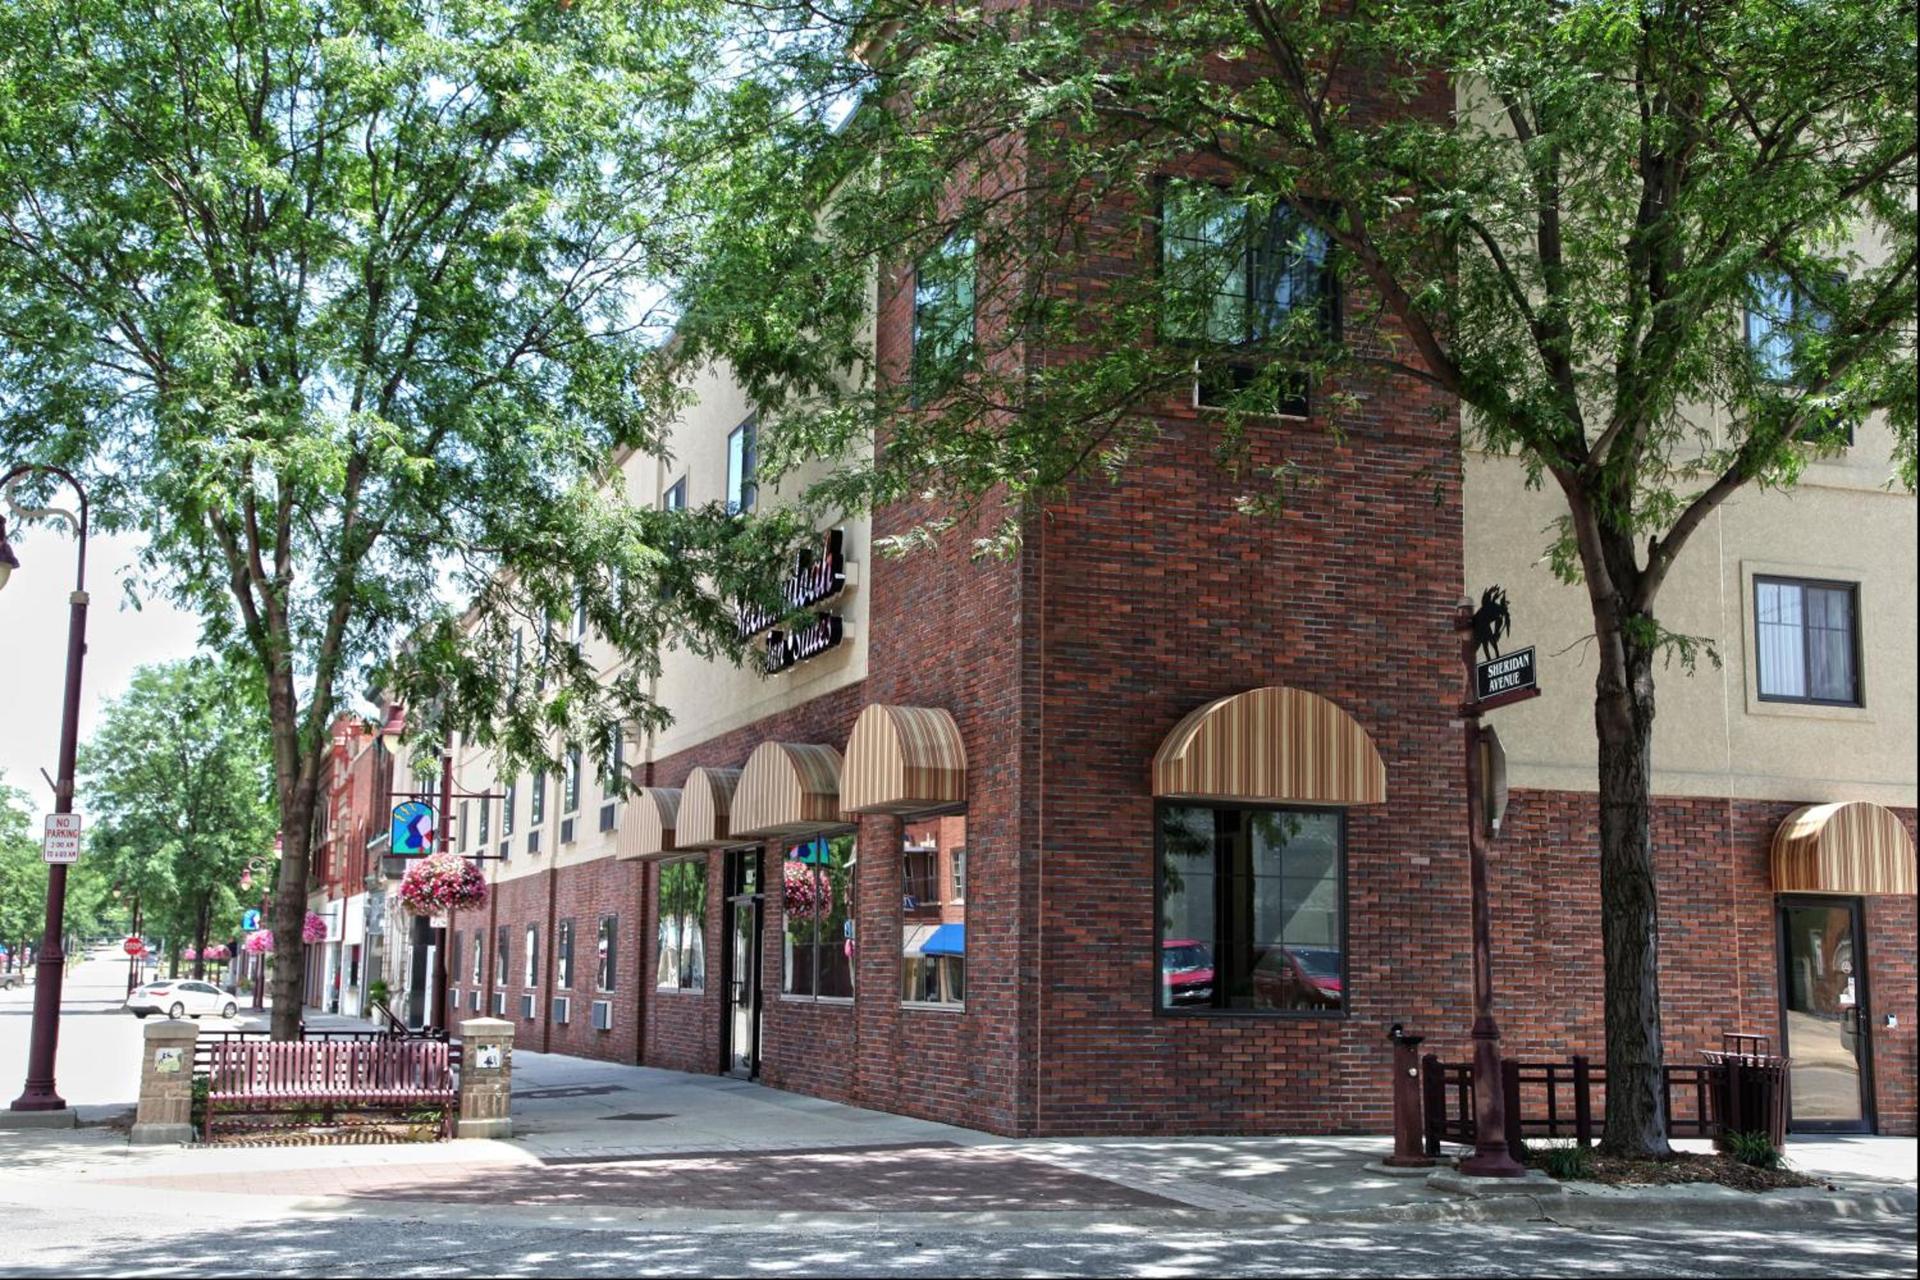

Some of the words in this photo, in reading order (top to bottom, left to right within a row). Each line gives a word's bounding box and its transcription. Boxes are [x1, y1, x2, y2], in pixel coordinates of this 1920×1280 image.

[1488, 653, 1530, 678] SHERIDAN
[1489, 672, 1520, 692] AVENUE
[56, 818, 70, 828] NO
[47, 829, 79, 838] PARKING
